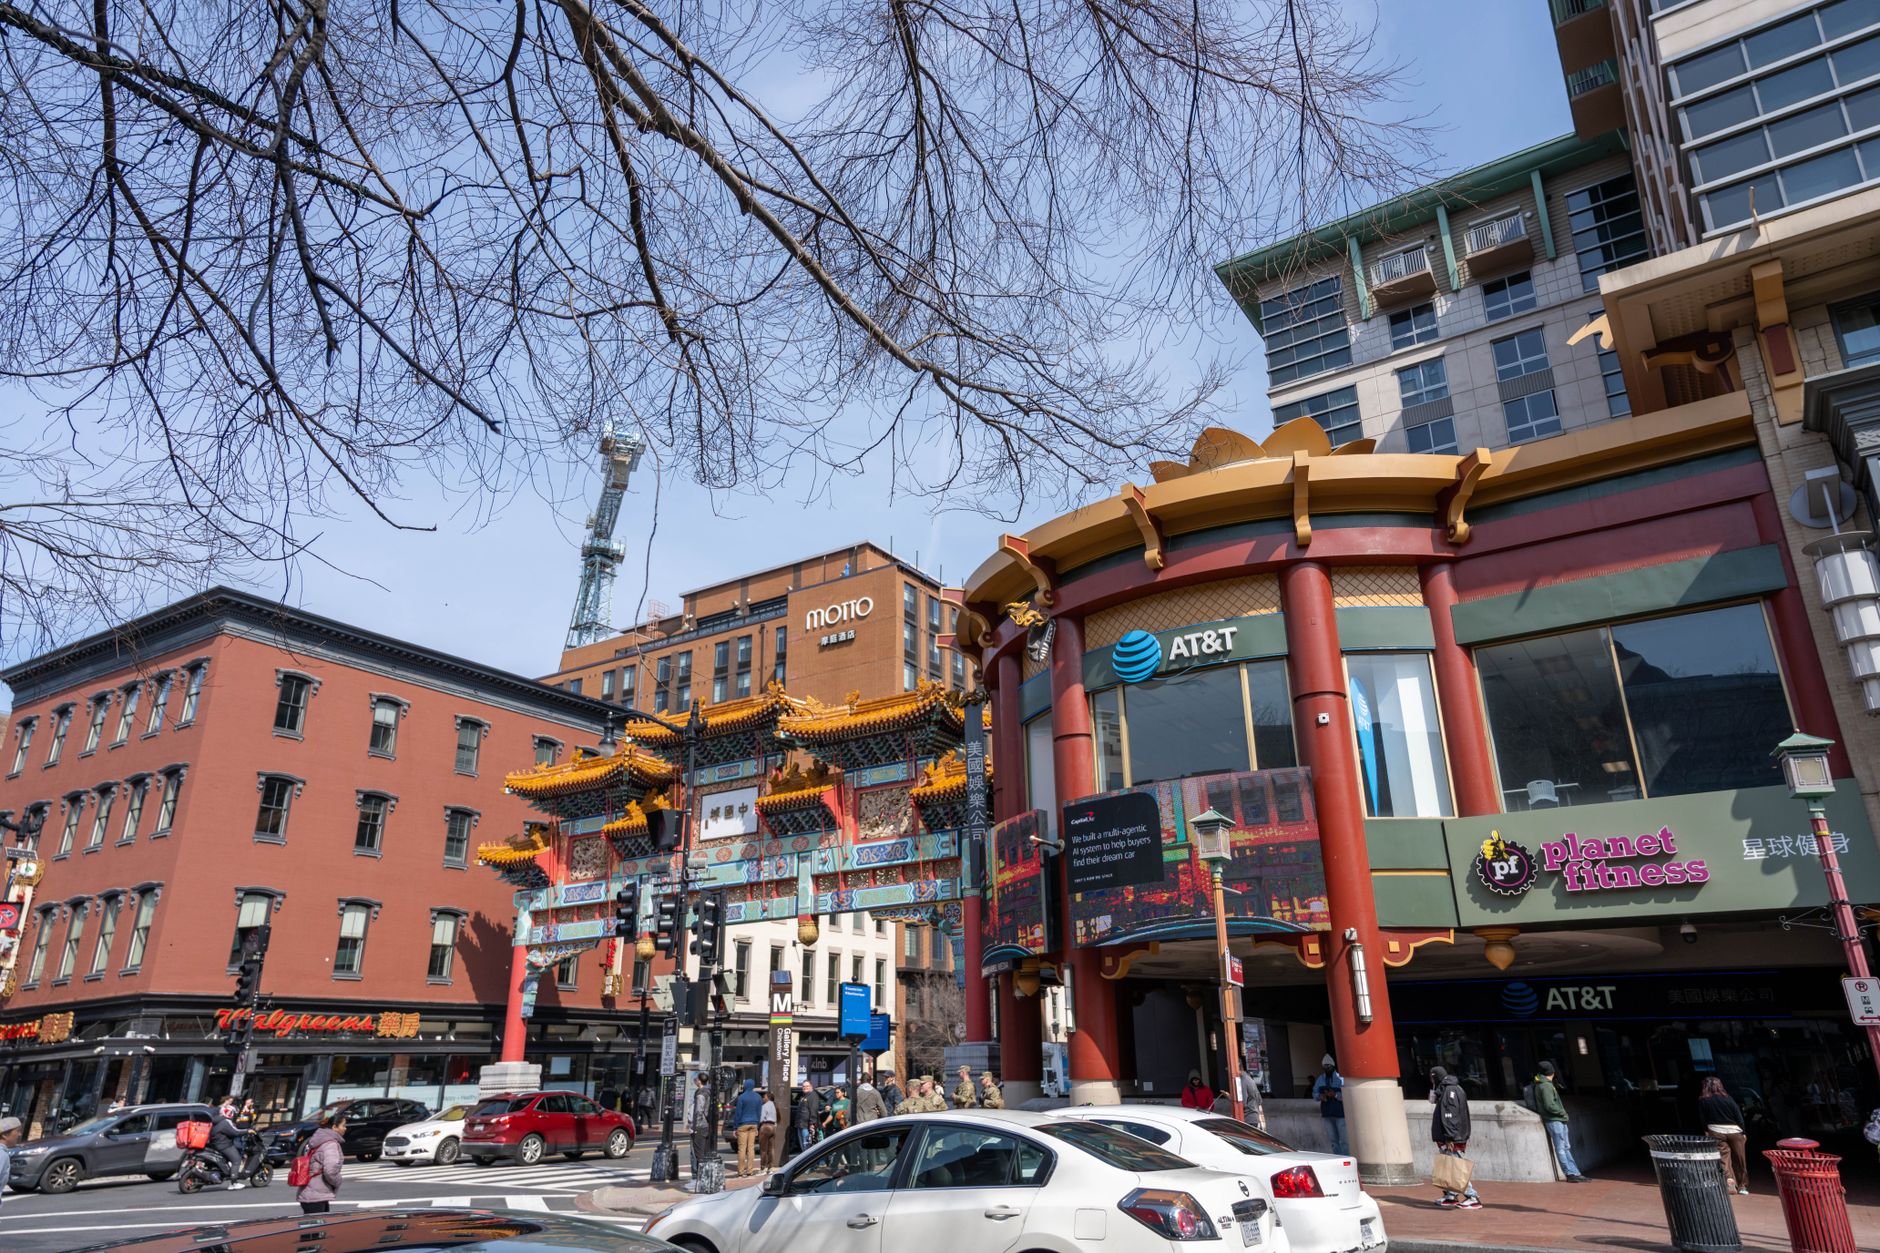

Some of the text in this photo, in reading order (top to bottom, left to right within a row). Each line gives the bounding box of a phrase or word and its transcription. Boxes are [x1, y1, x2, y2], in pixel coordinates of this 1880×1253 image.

[1168, 626, 1238, 661] AT&T
[1072, 823, 1148, 844] We built a multi-agentic
[1080, 844, 1102, 856] system
[1103, 842, 1111, 851] to
[1111, 839, 1126, 849] help
[1127, 836, 1152, 848] buyers
[1073, 851, 1136, 867] find their dream car
[1540, 824, 1678, 872] planet
[1492, 855, 1520, 880] pf
[1563, 858, 1711, 892] fitness
[773, 993, 792, 1012] M
[1546, 986, 1617, 1011] AT&T
[215, 1007, 376, 1038] Walgreens
[776, 1027, 784, 1060] Chinatown
[782, 1027, 792, 1082] Gallery Place
